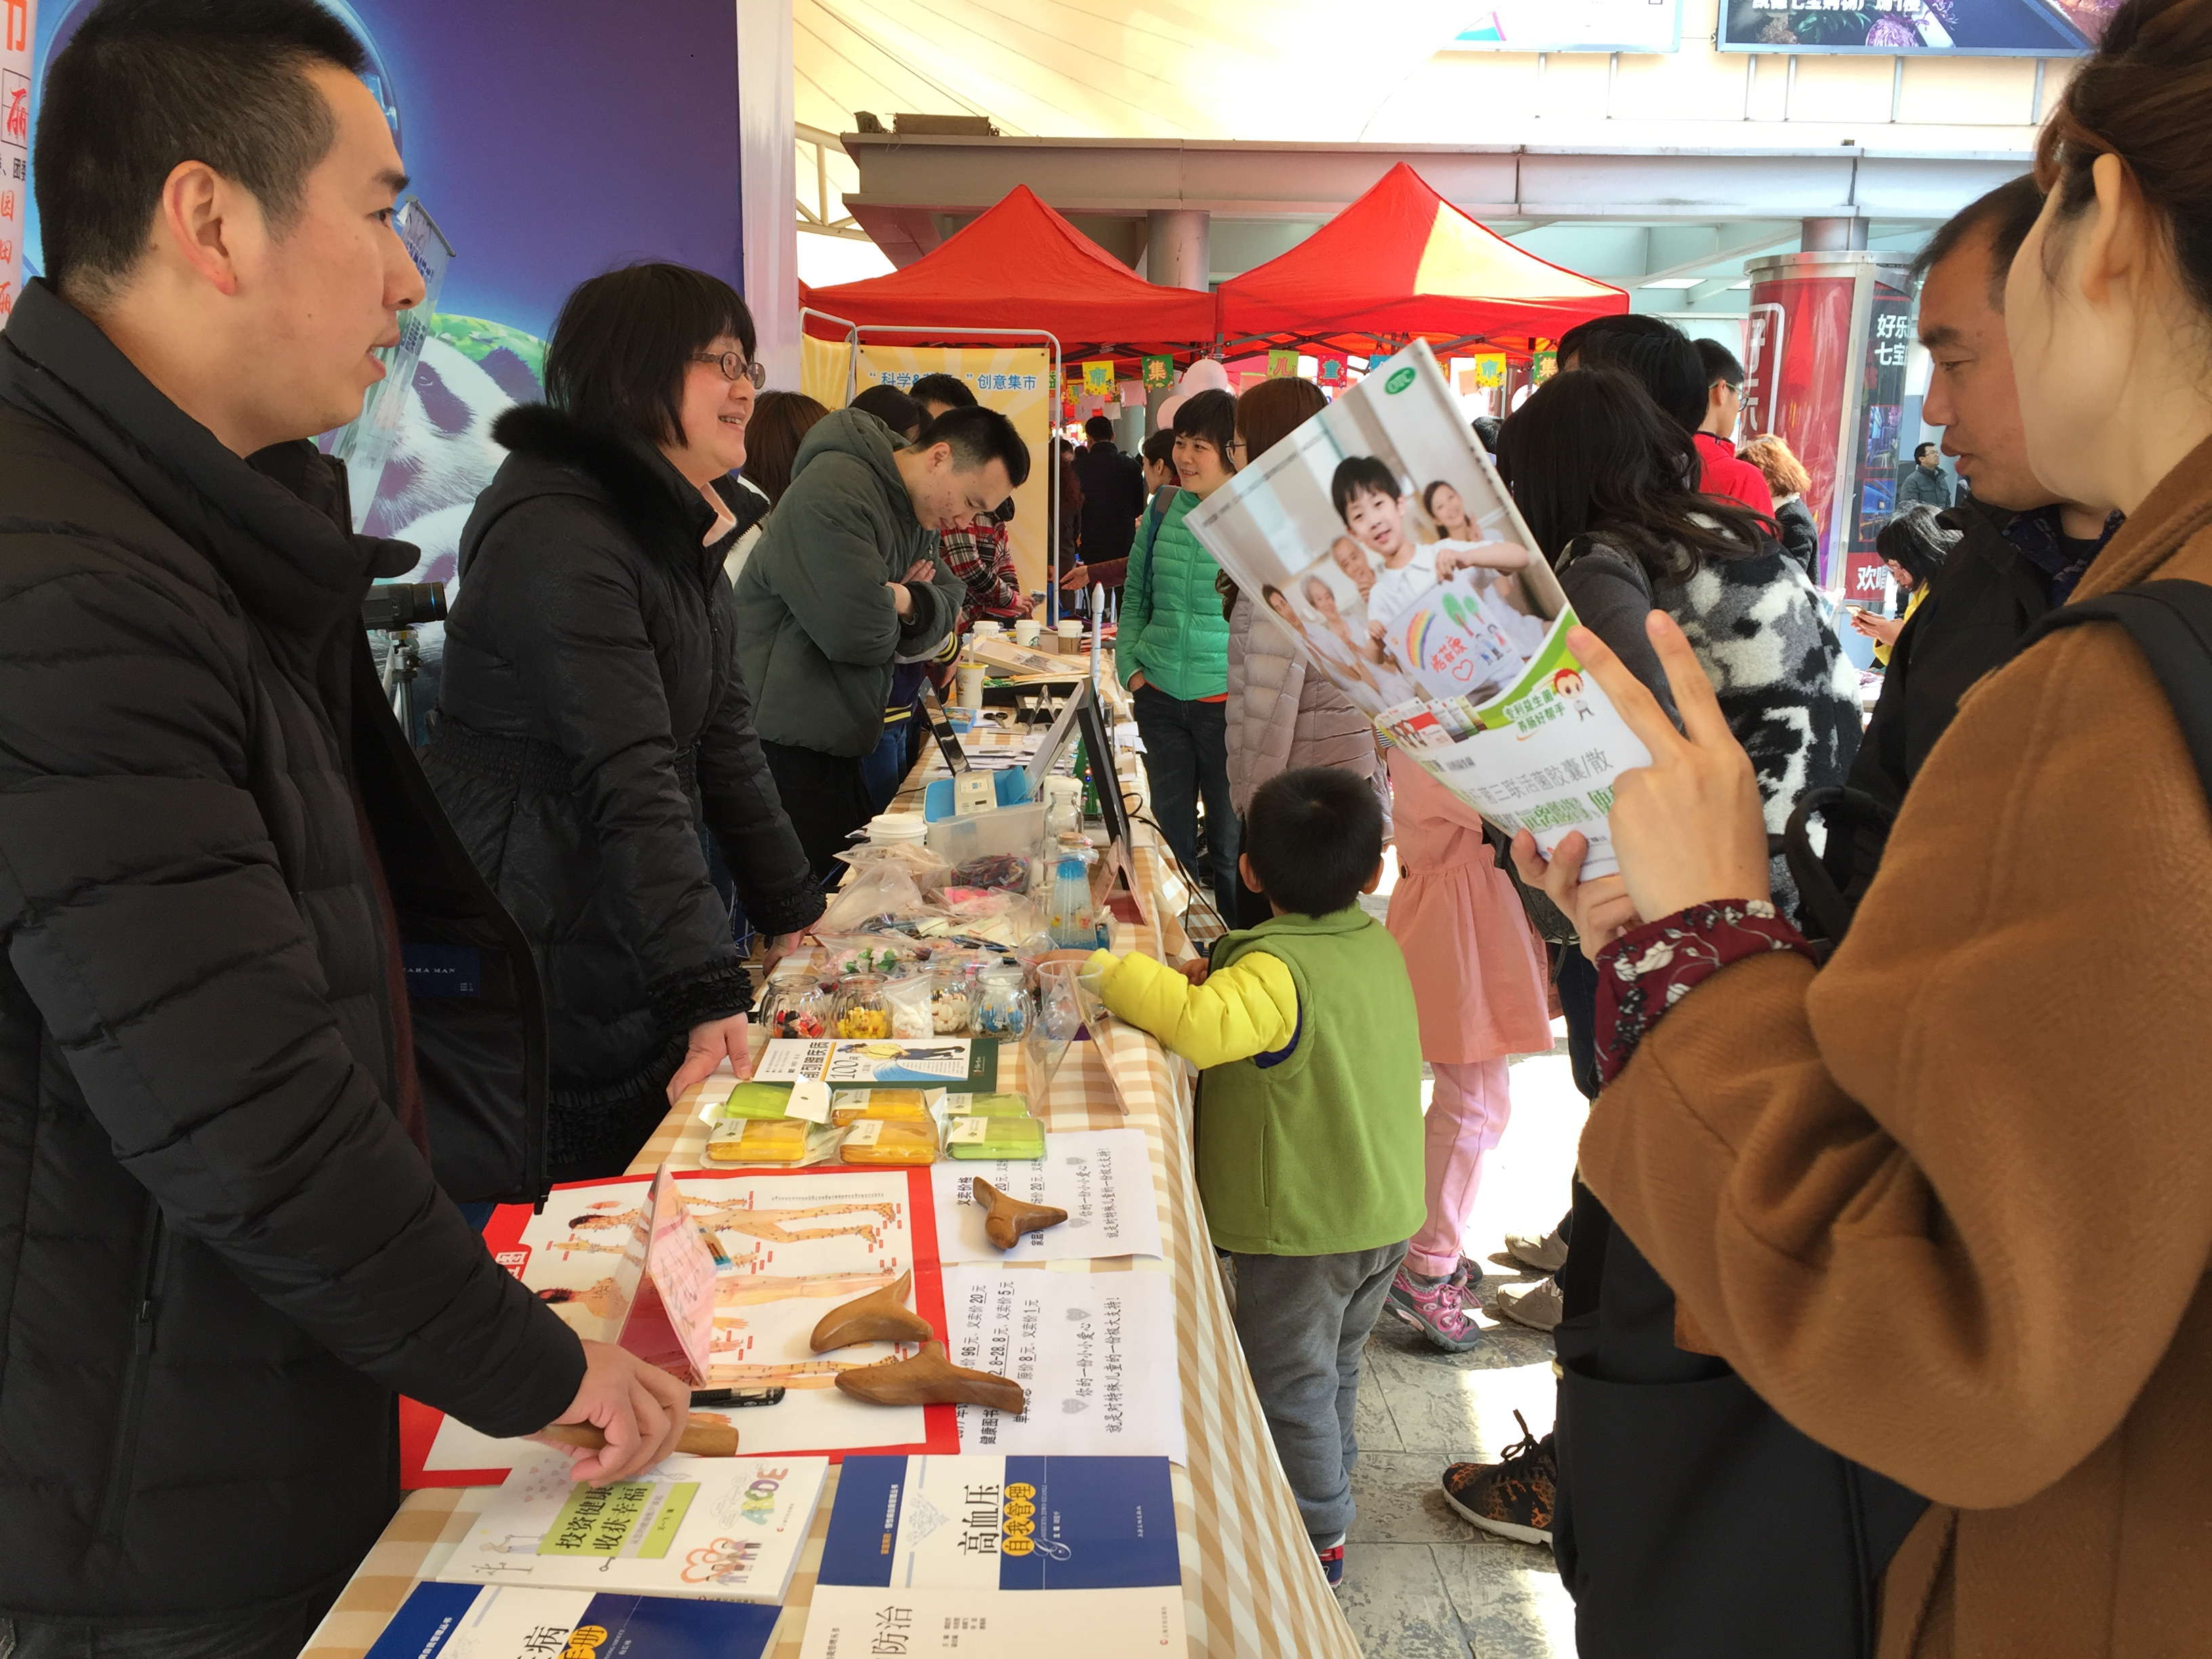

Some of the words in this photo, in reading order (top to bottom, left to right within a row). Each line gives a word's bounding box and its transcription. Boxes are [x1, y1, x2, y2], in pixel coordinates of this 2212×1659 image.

[1088, 367, 1107, 387] 市
[1147, 360, 1166, 382] 集
[1273, 356, 1296, 377] 儿
[1480, 359, 1500, 380] 市
[1540, 357, 1558, 378] 集
[1875, 341, 1908, 366] 七宝
[1076, 1164, 1093, 1218] 你的一份小小爱心
[1075, 1322, 1095, 1398] 你的一份小小爱心
[554, 1484, 615, 1551] 投资健康
[592, 1486, 650, 1551] 收获幸福
[740, 1467, 790, 1526] ABCDE
[957, 1484, 1000, 1556] 高血压
[1005, 1485, 1032, 1552] 自我管理
[871, 1605, 914, 1659] 防治
